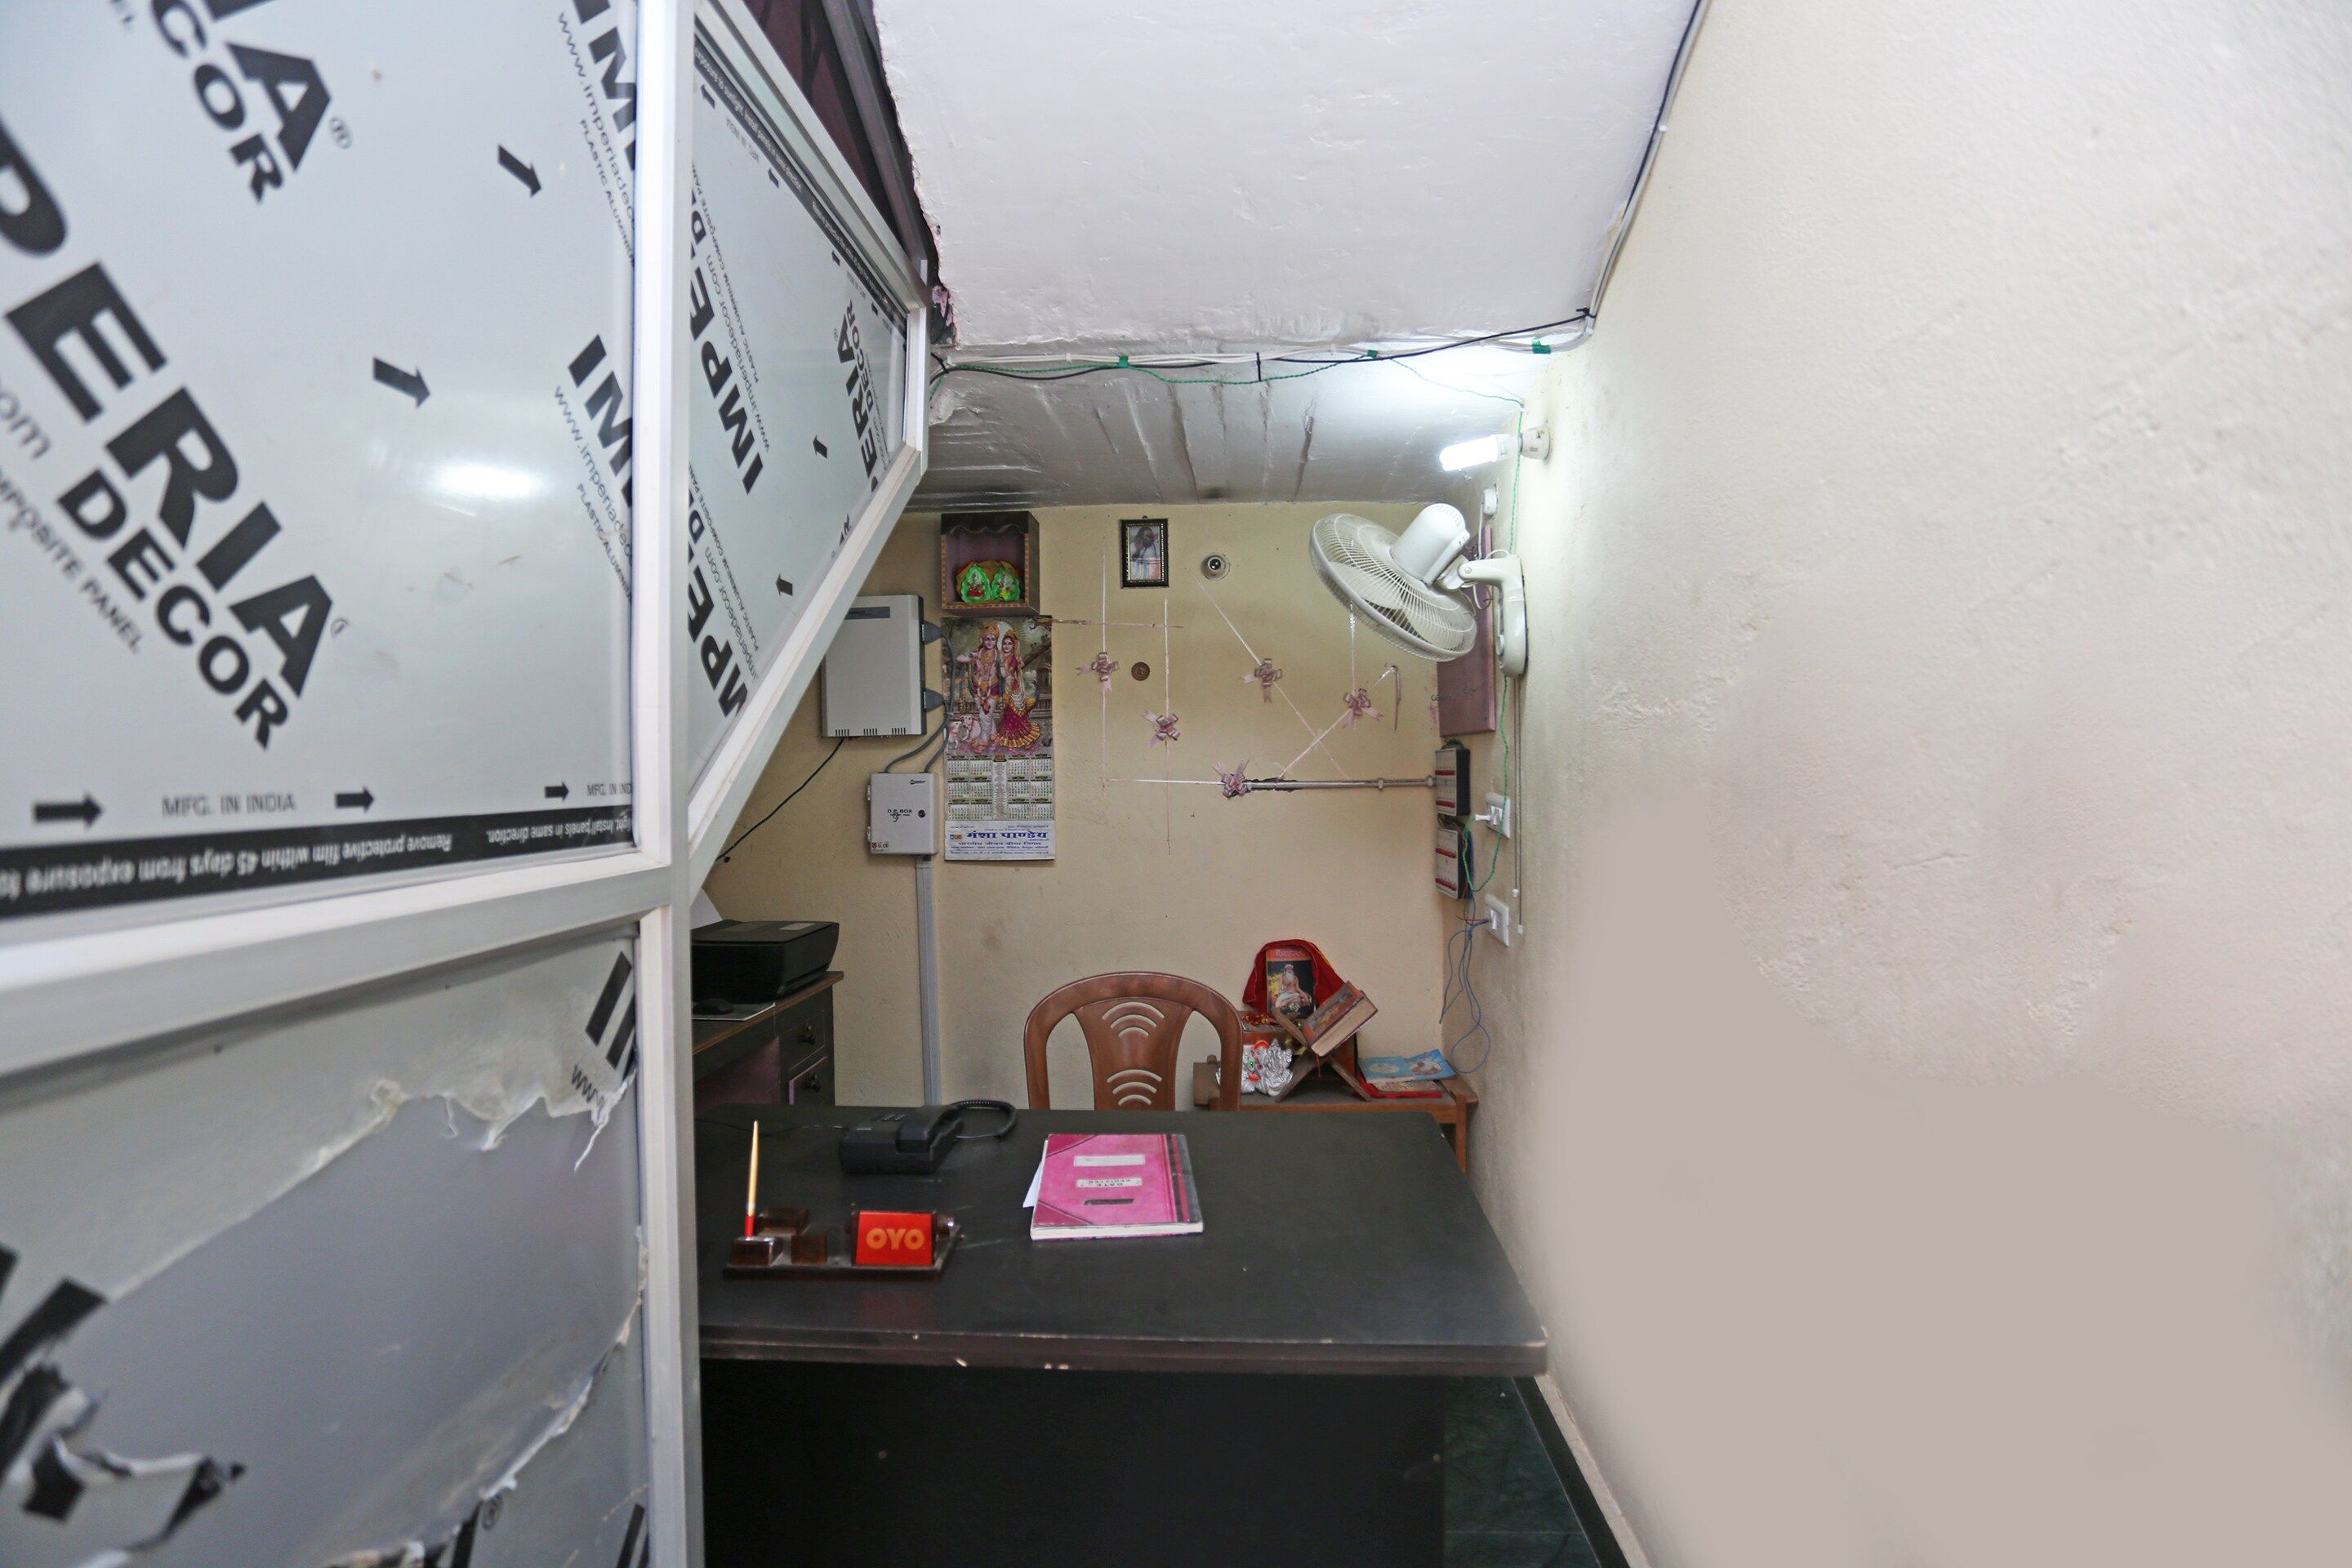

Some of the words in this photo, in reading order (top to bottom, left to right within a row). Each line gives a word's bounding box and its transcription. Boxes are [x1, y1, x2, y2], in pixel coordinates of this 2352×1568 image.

[580, 118, 608, 187] PLASTIC
[723, 272, 746, 336] ALUMINIUM
[689, 241, 764, 496] IMPE
[706, 254, 770, 453] www.imperiadecor.com
[742, 337, 759, 385] PLASTIC
[846, 298, 874, 412] DECOR
[697, 493, 724, 556] COMPOSITE
[722, 557, 745, 611] ALUMINIUM
[57, 467, 288, 751] DECOR
[79, 576, 142, 655] PANEL
[742, 612, 760, 652] PLASTIC
[220, 794, 240, 814] IN
[246, 791, 296, 813] INDIA
[608, 782, 617, 795] IN
[486, 826, 529, 845] direction.
[531, 824, 554, 839] same
[554, 823, 564, 839] in
[564, 818, 590, 838] panels
[590, 816, 613, 835] Install
[312, 842, 341, 866] film
[342, 833, 406, 862] protective
[407, 832, 452, 852] Remove
[138, 855, 187, 884] from
[189, 846, 235, 878] days
[261, 844, 310, 872] within
[25, 854, 137, 896] exposure
[865, 1227, 925, 1251] OYO
